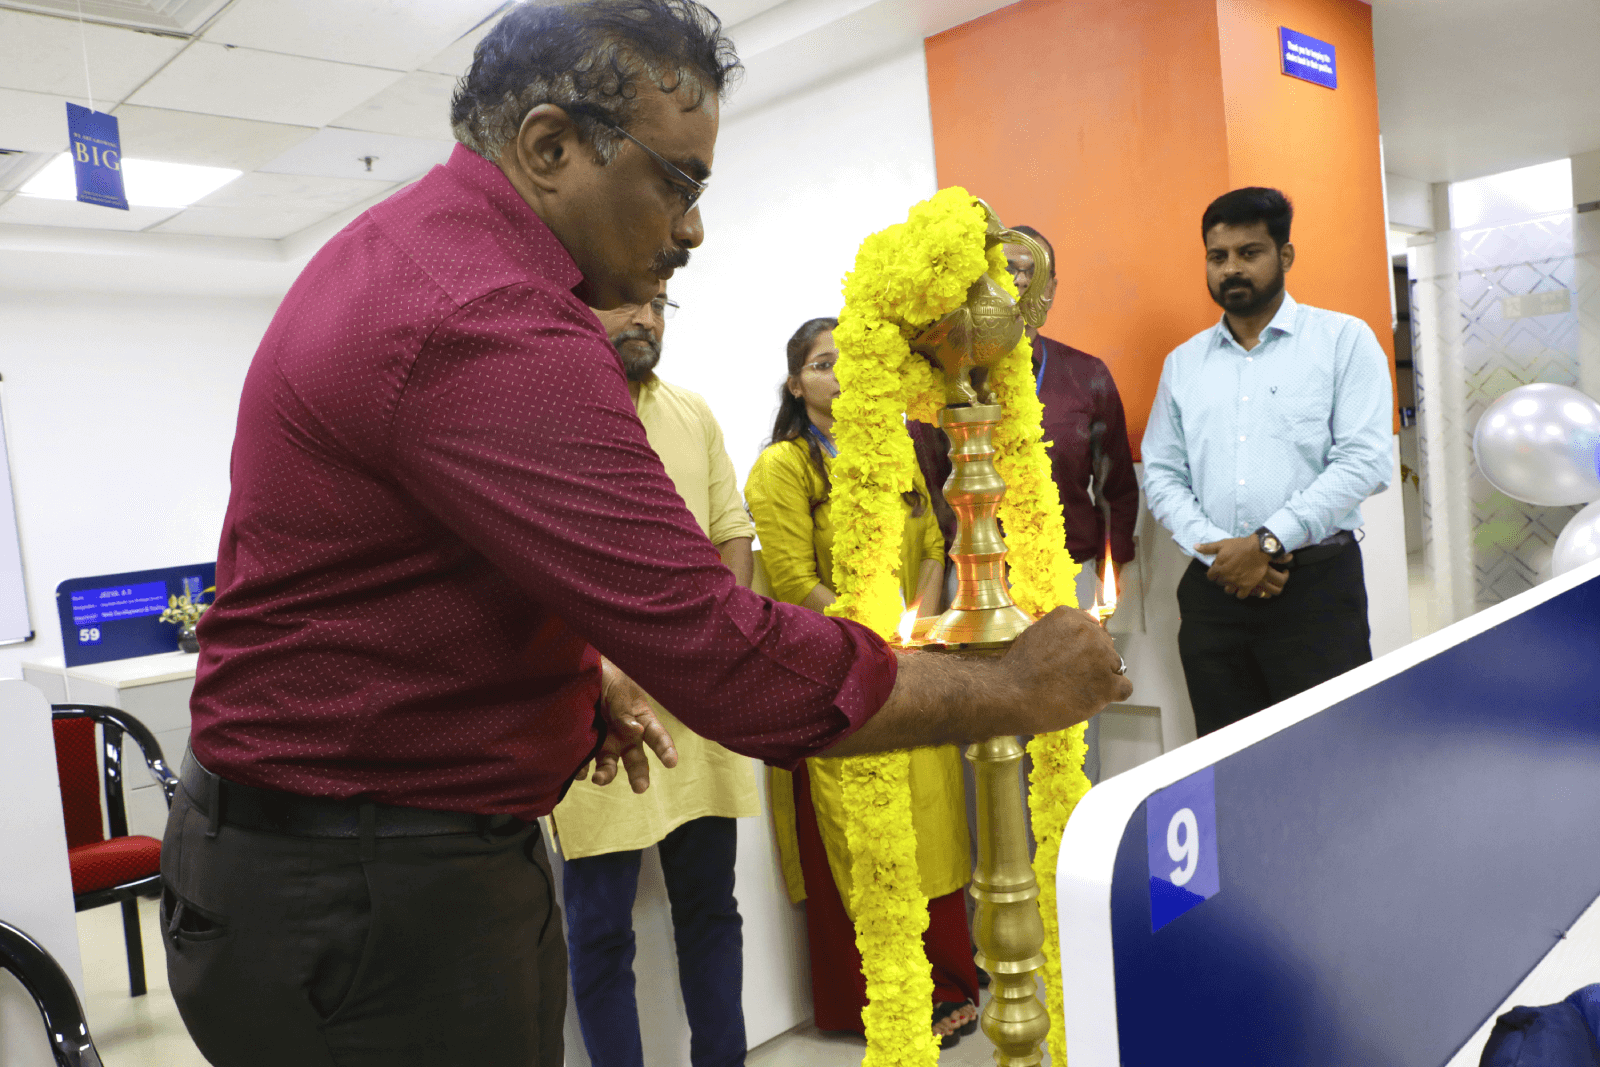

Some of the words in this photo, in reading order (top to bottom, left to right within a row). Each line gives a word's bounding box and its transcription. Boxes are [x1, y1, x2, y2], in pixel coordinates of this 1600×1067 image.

[75, 141, 120, 170] BIG
[79, 628, 100, 642] 59
[1167, 807, 1200, 887] 9
